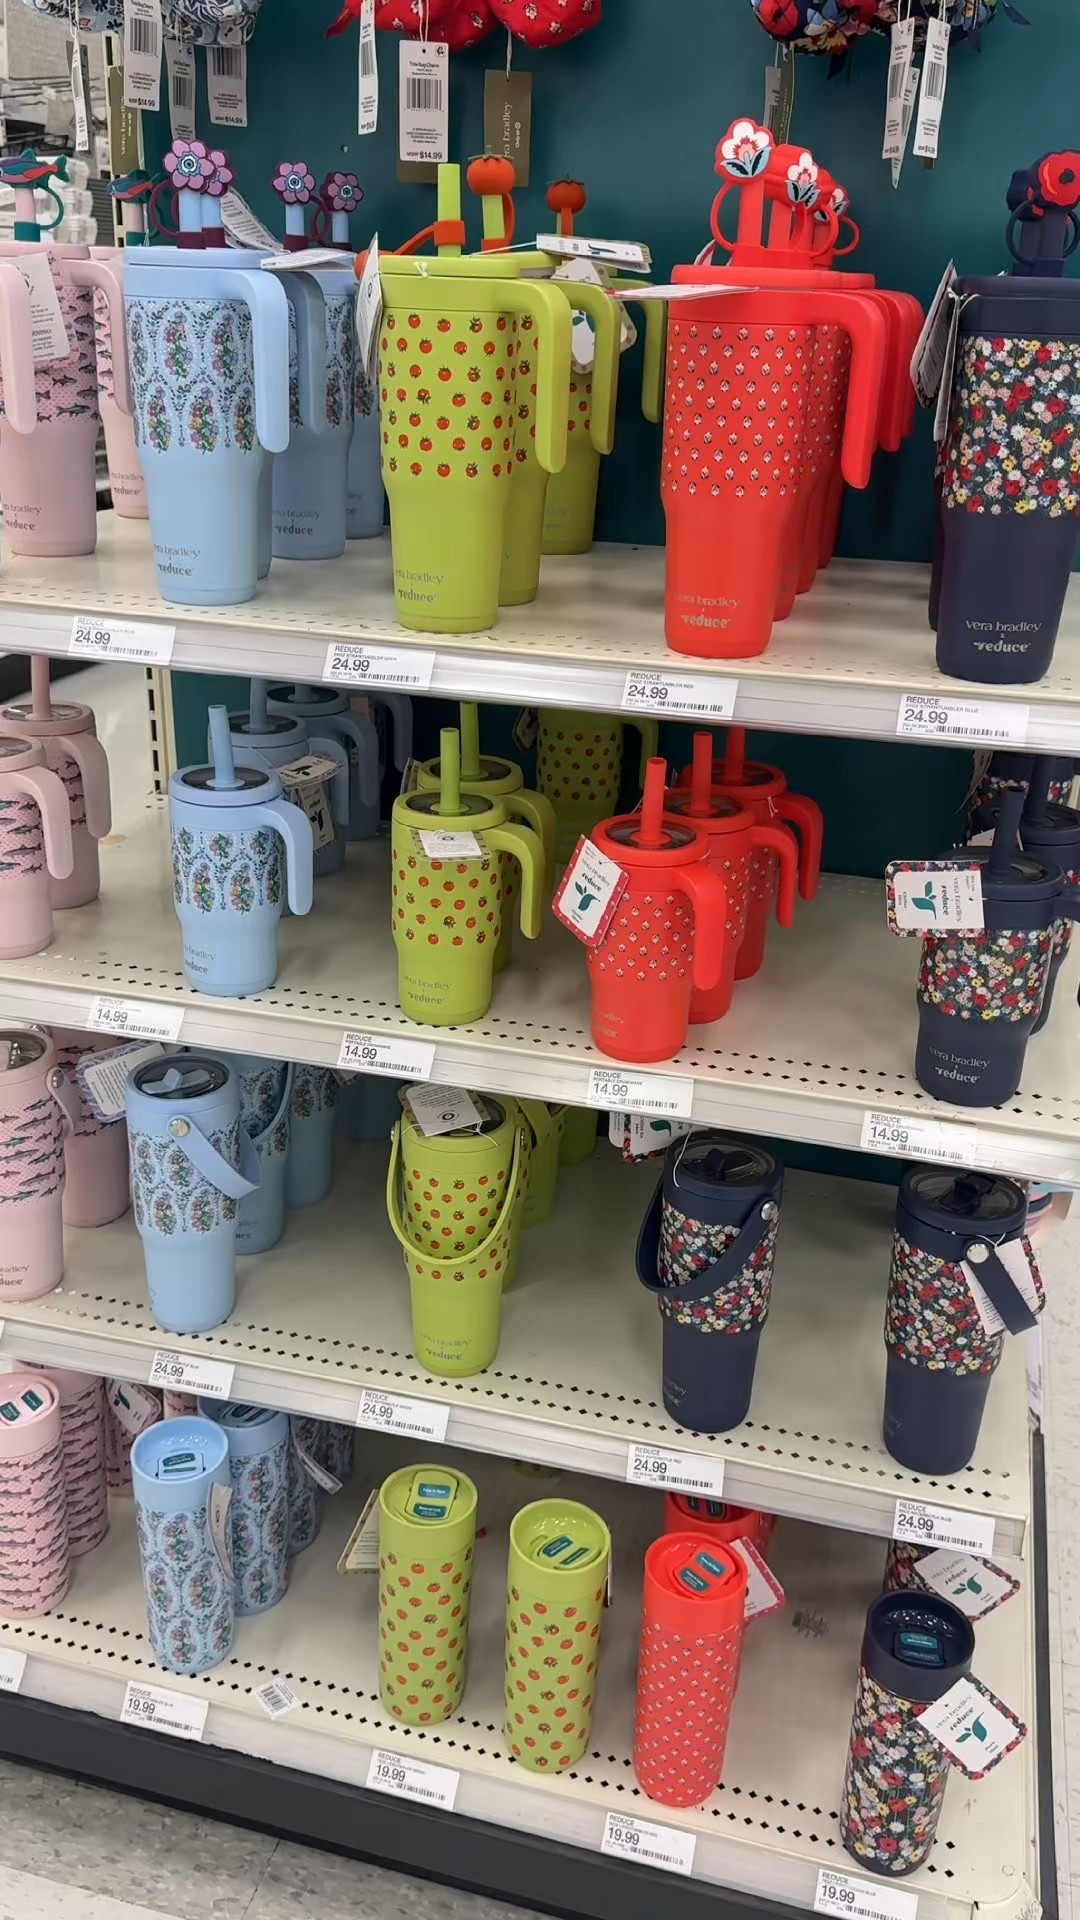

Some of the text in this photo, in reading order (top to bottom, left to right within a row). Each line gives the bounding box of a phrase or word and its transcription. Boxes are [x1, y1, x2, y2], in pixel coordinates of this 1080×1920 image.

[502, 103, 512, 141] bradley
[419, 151, 443, 159] $14.99
[274, 523, 314, 535] reduce
[157, 562, 193, 577] reduce
[995, 621, 1042, 633] bradley
[75, 630, 111, 645] 24.99
[334, 645, 364, 654] REDUCE
[973, 640, 1030, 653] reduce
[331, 658, 370, 672] 24.99
[630, 672, 662, 680] REDUCE
[627, 684, 669, 700] 24.99
[905, 695, 940, 705] REDUCE
[904, 708, 949, 724] 24.99
[581, 872, 602, 892] reduce
[941, 885, 950, 916] reduce
[97, 1008, 128, 1023] 14.99
[346, 1033, 372, 1043] REDUCE
[345, 1045, 377, 1060] 14.99
[951, 1053, 990, 1069] bradley
[593, 1071, 621, 1079] REDUCE
[935, 1066, 980, 1084] reduce
[593, 1083, 628, 1097] 14.99
[871, 1114, 901, 1124] REDUCE
[870, 1126, 909, 1143] 14.99
[157, 1352, 180, 1360] REDUCE
[153, 1362, 184, 1377] 24.99
[364, 1391, 388, 1401] REDUCE
[361, 1403, 393, 1418] 24.99
[635, 1446, 661, 1456] REDUCE
[633, 1458, 667, 1474] 24.99
[899, 1501, 927, 1512] REDUCE
[897, 1513, 934, 1531] 24.99
[129, 1686, 152, 1697] REDUCE
[128, 1698, 156, 1715] 19.99
[950, 1706, 974, 1731] reduce
[378, 1751, 401, 1763] REDUCE
[376, 1764, 405, 1782] 19.99
[609, 1814, 634, 1826] REDUCE
[608, 1827, 640, 1845] 19.99
[822, 1871, 848, 1884] REDUCE
[821, 1884, 855, 1904] 19.99
